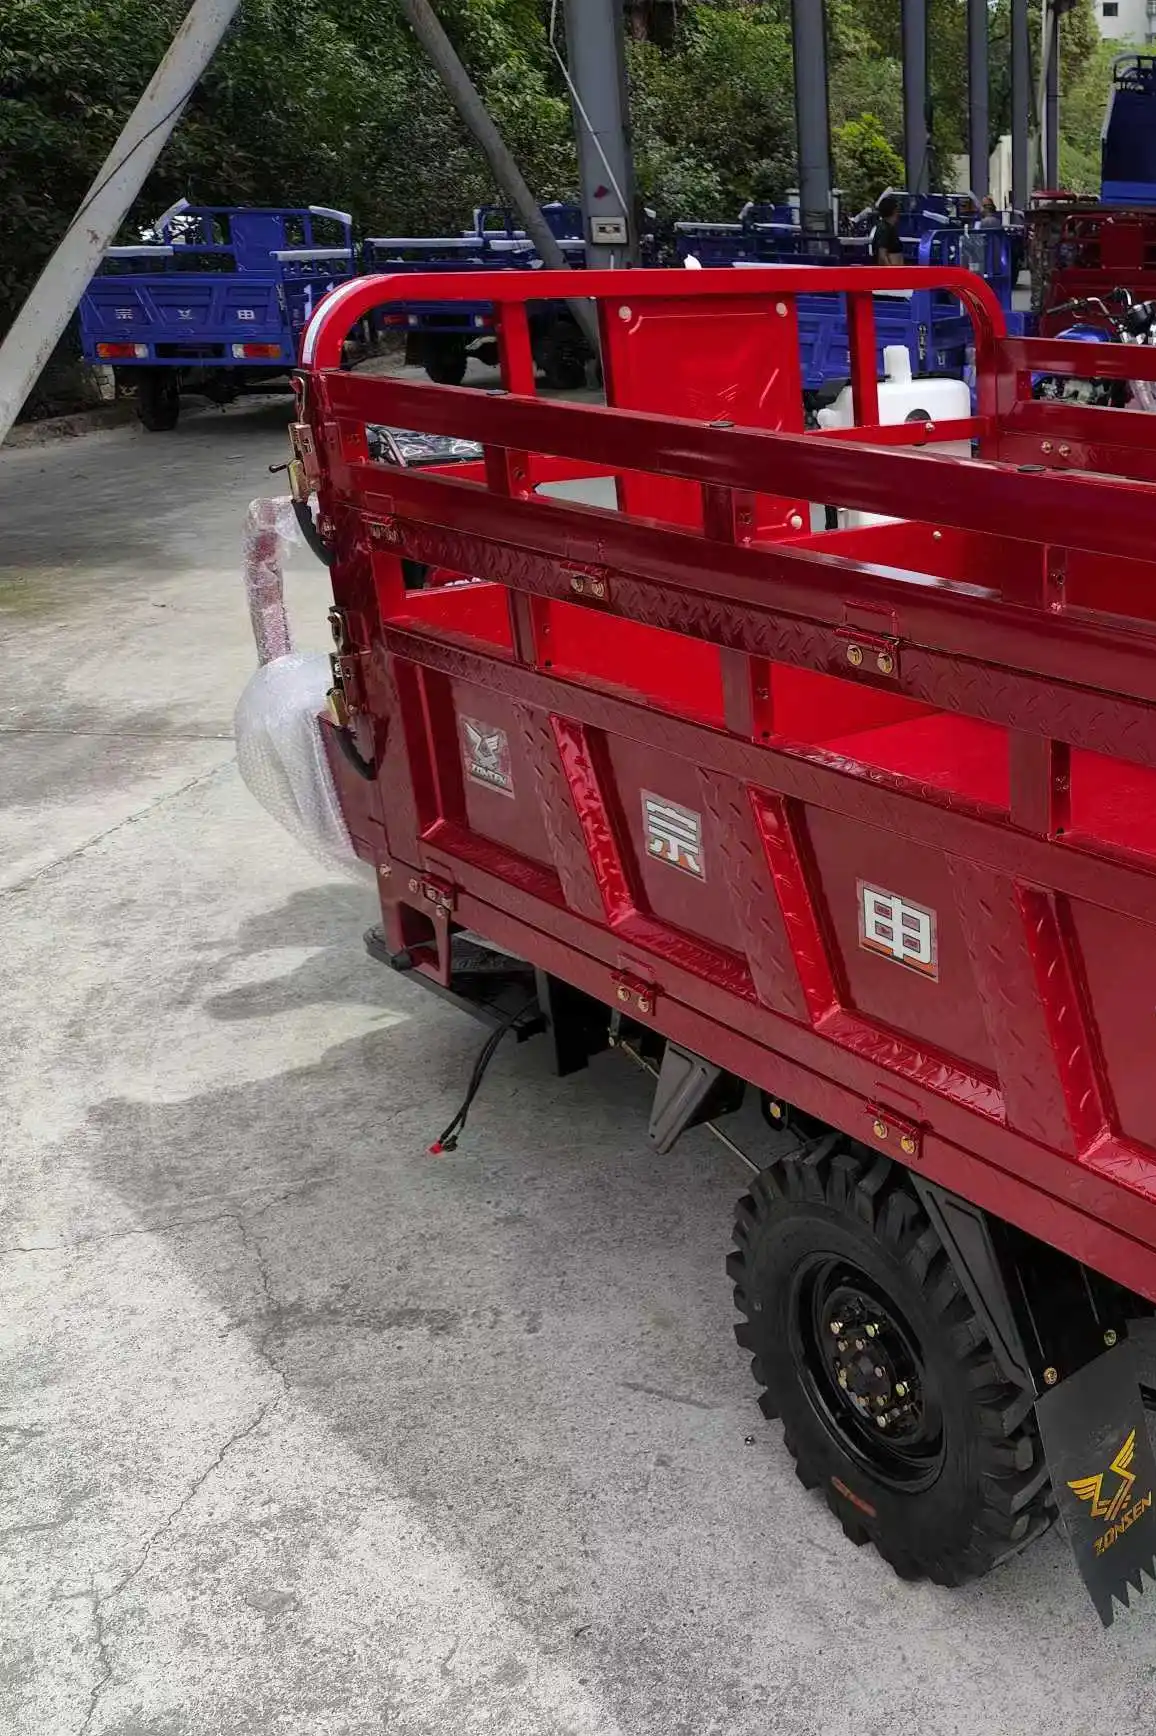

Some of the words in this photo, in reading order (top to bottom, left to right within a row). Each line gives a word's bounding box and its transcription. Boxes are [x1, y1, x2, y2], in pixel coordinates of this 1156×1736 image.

[646, 799, 701, 873] 宗
[863, 887, 931, 964] 申
[1094, 1490, 1152, 1556] ZONSEN
